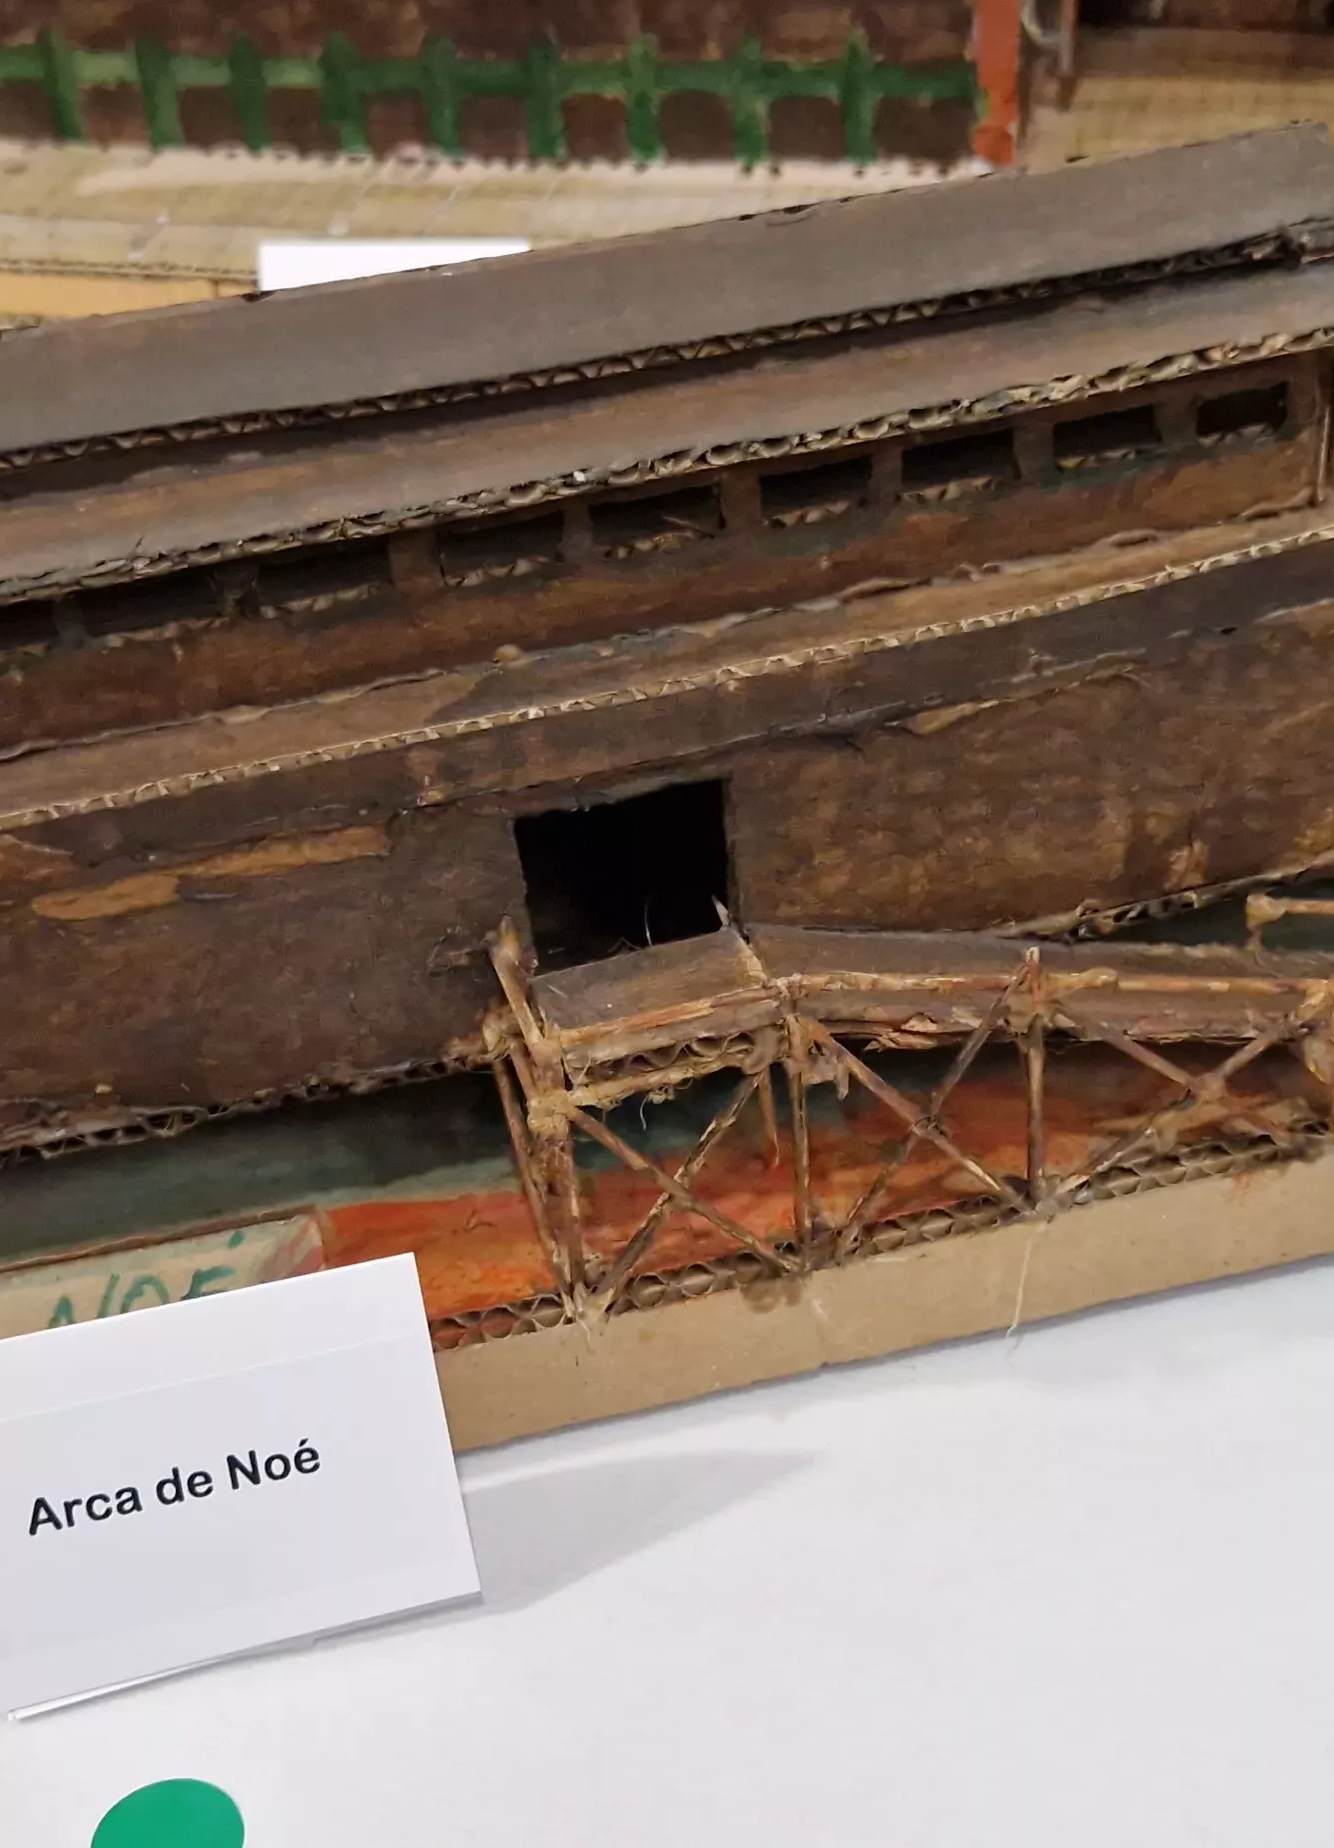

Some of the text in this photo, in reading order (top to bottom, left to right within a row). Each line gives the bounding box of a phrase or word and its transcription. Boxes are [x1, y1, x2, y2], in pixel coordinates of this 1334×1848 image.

[29, 1438, 321, 1536] Arca de Noé
